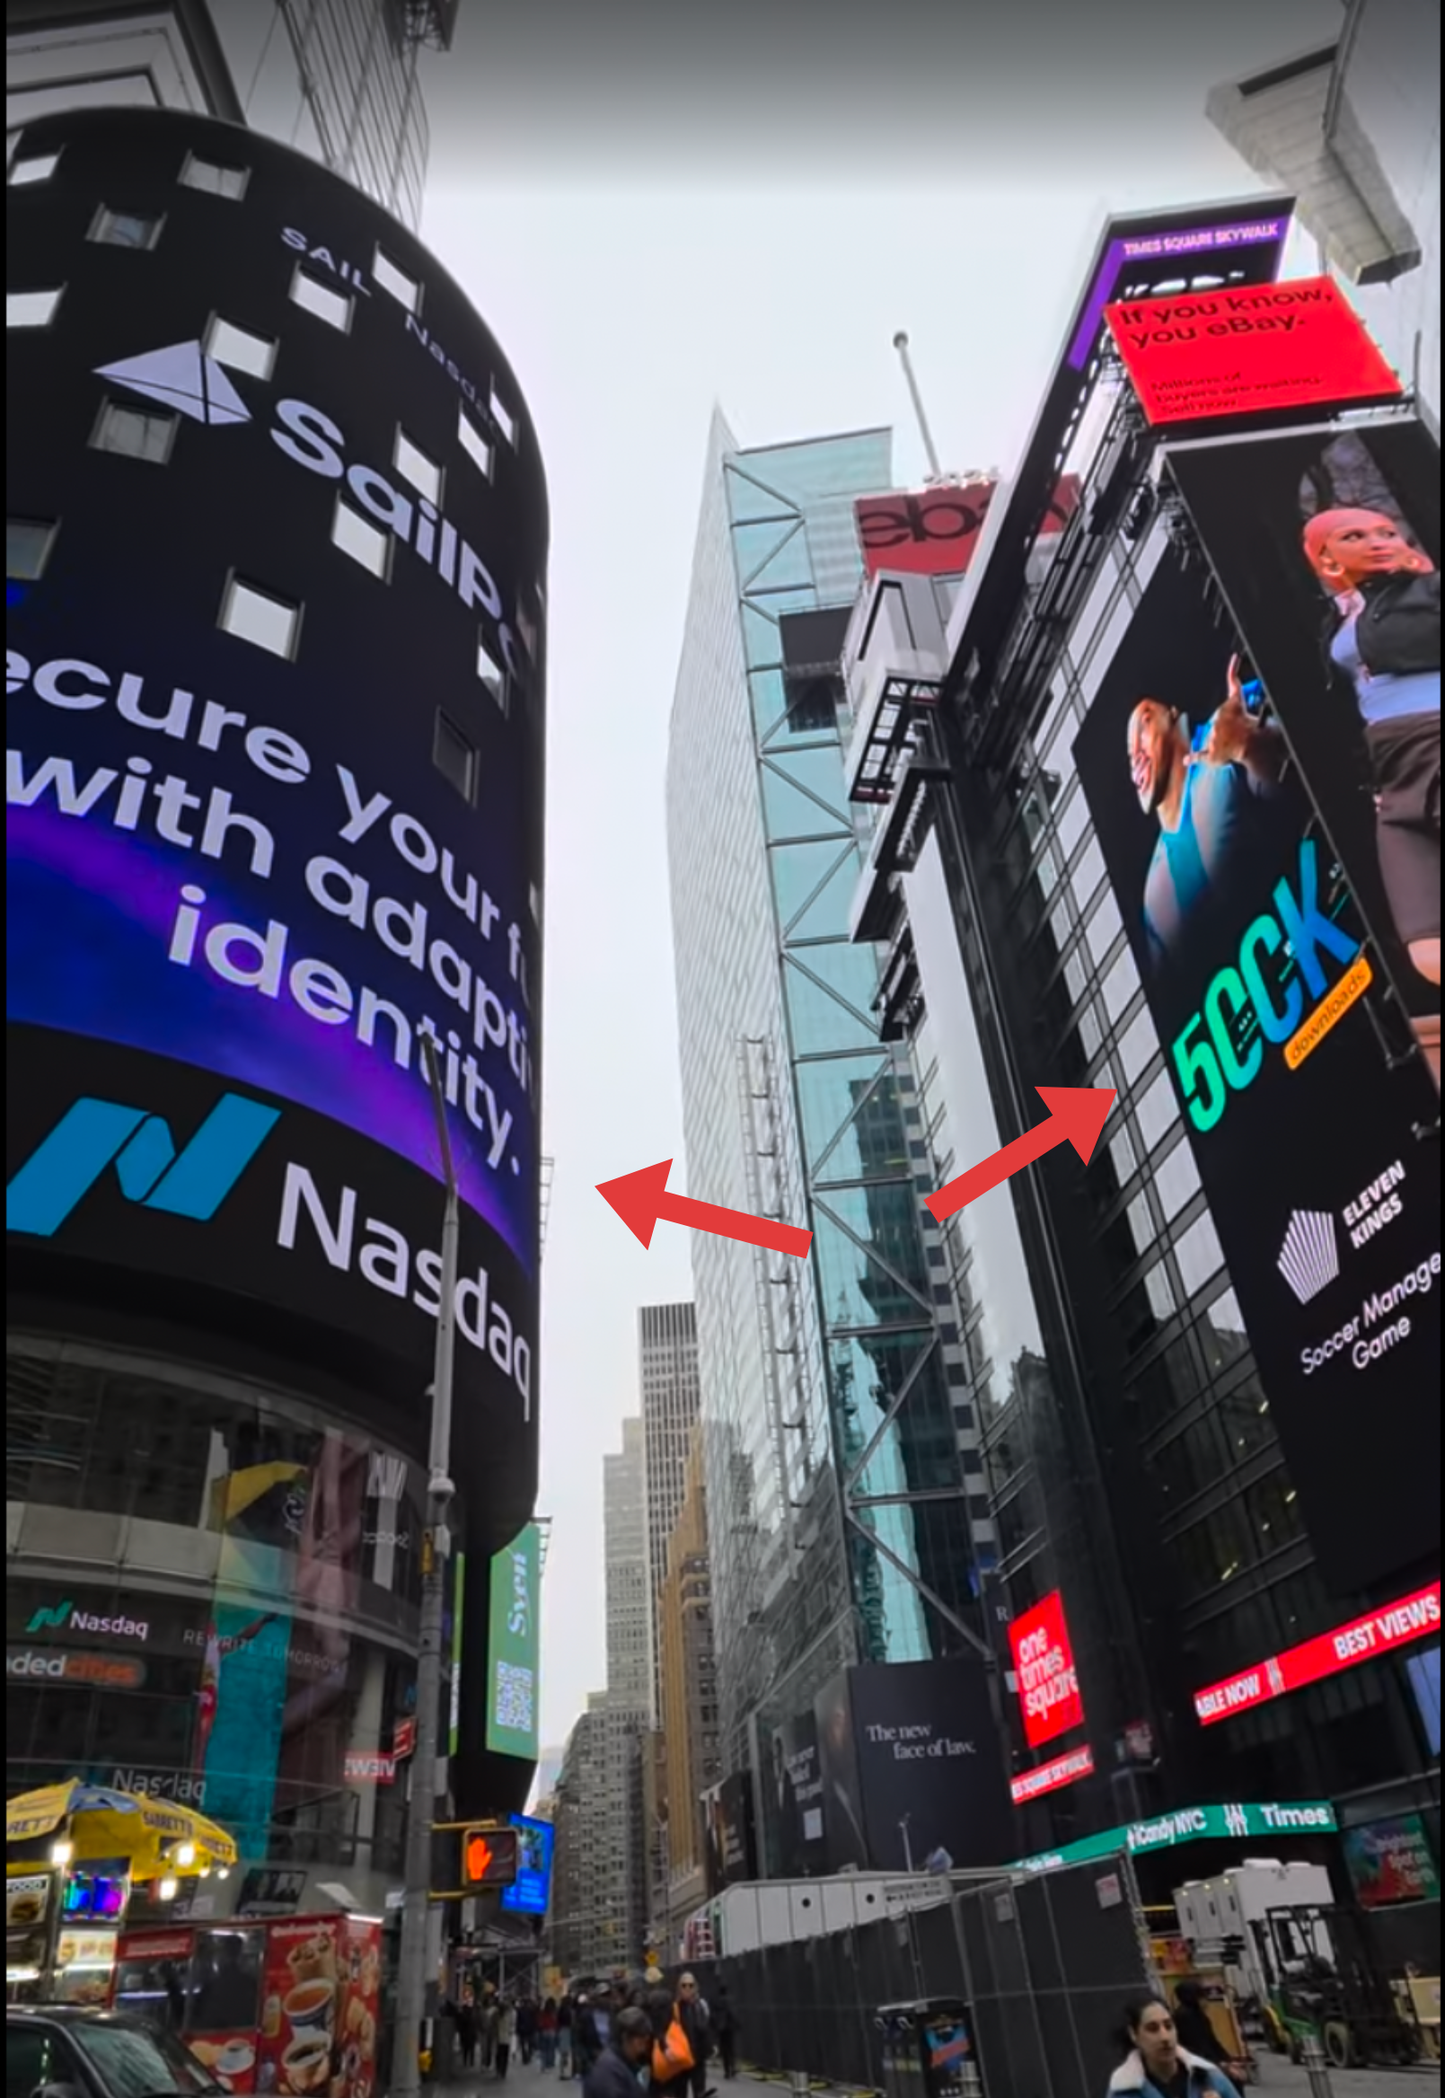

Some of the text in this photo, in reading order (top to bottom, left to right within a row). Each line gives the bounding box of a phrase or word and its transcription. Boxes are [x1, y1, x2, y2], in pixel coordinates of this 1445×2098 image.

[281, 226, 371, 297] SAIL
[1124, 223, 1278, 256] TIMES SQUARE SKYWALK
[1131, 313, 1306, 349] you eBay.
[1153, 299, 1218, 324] you
[1225, 288, 1333, 311] know,
[406, 313, 500, 432] Nasda
[337, 764, 499, 940] your
[6, 750, 534, 1110] with adapti
[169, 884, 520, 1175] identity.
[1290, 968, 1367, 1062] downloads
[1342, 1160, 1406, 1226] ELEVEN
[1350, 1192, 1403, 1249] KINGS
[277, 1162, 531, 1422] Nasdaq
[1300, 1315, 1360, 1375] Soccer
[1352, 1316, 1411, 1369] Game
[70, 1611, 149, 1641] Nasdaq
[1018, 1627, 1048, 1664] one
[1333, 1595, 1440, 1660] BEST VIEWS
[1020, 1645, 1065, 1691] times
[1224, 1673, 1261, 1705] NOW
[866, 1723, 932, 1742] The new
[893, 1739, 976, 1760] face of law.
[1176, 1808, 1208, 1836] NYC
[1260, 1804, 1330, 1827] Times
